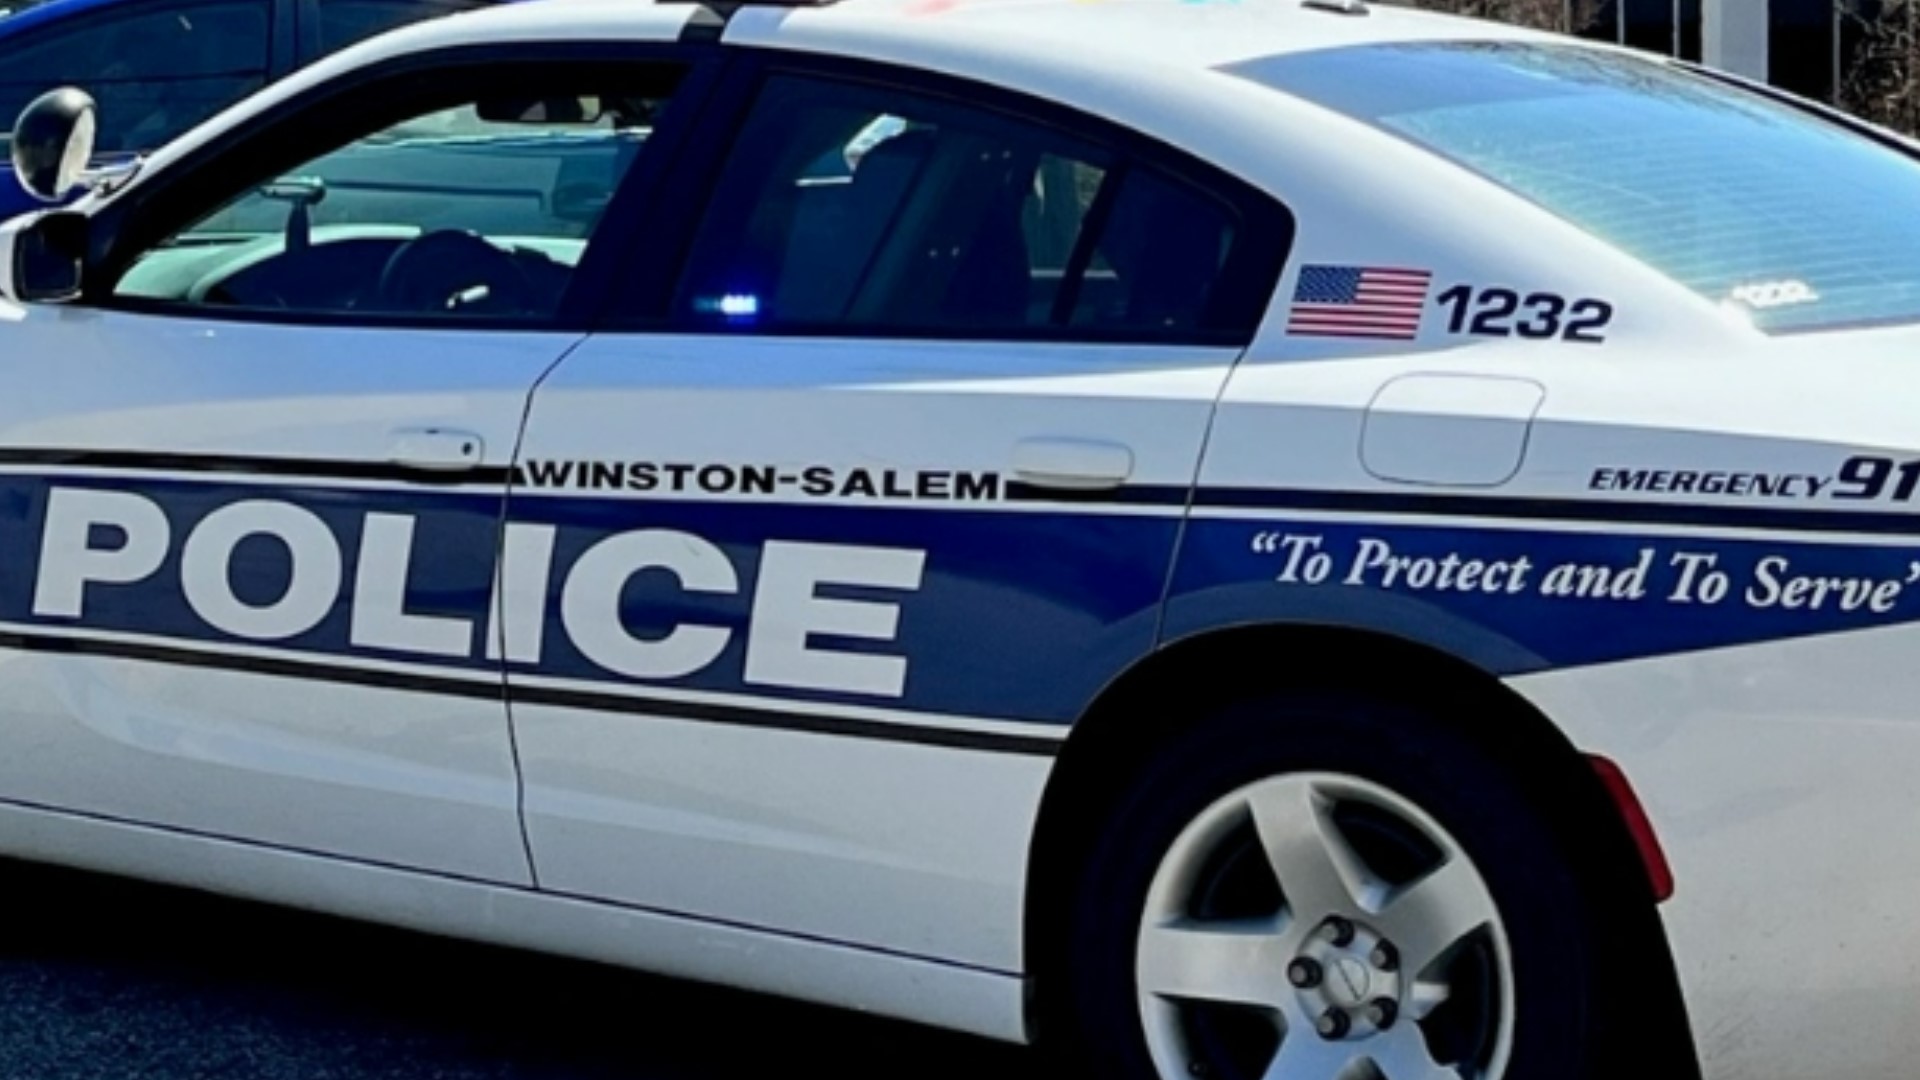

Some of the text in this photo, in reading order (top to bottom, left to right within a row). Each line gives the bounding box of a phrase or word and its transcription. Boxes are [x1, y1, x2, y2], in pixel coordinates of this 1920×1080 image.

[1436, 285, 1612, 343] 1232
[527, 459, 998, 500] WINSTON-SALEM
[1589, 467, 1832, 498] EMERGENCY
[32, 486, 926, 698] POLICE
[1252, 531, 1332, 584] “To
[1342, 538, 1532, 594] Protect
[1540, 549, 1656, 600] and
[1668, 552, 1729, 604] To
